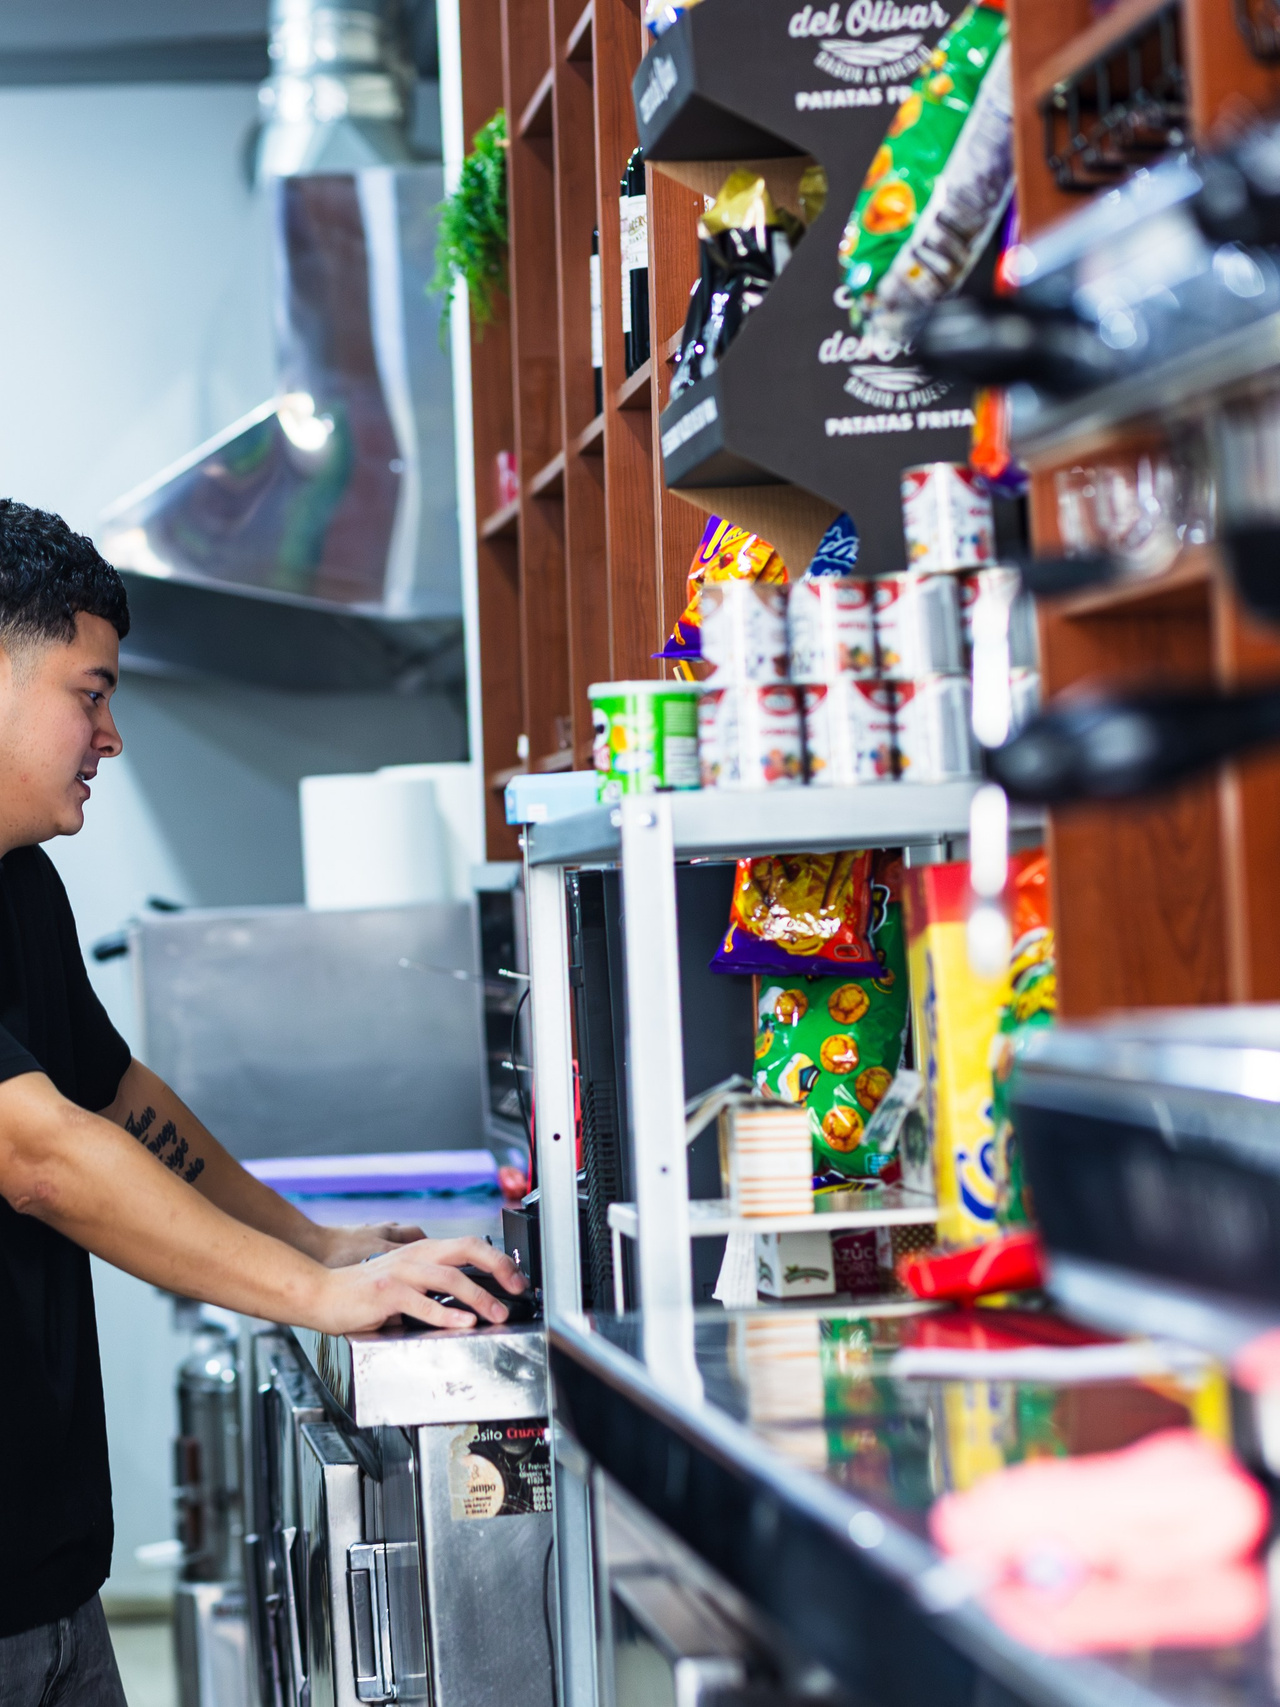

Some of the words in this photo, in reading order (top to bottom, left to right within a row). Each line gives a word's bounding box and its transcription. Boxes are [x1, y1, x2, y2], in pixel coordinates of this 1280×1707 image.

[788, 2, 842, 38] del
[845, 0, 950, 37] Olivar
[795, 87, 883, 111] PATATAS
[825, 413, 914, 436] PATATAS
[916, 408, 977, 430] FRITA
[469, 1483, 496, 1494] ampo
